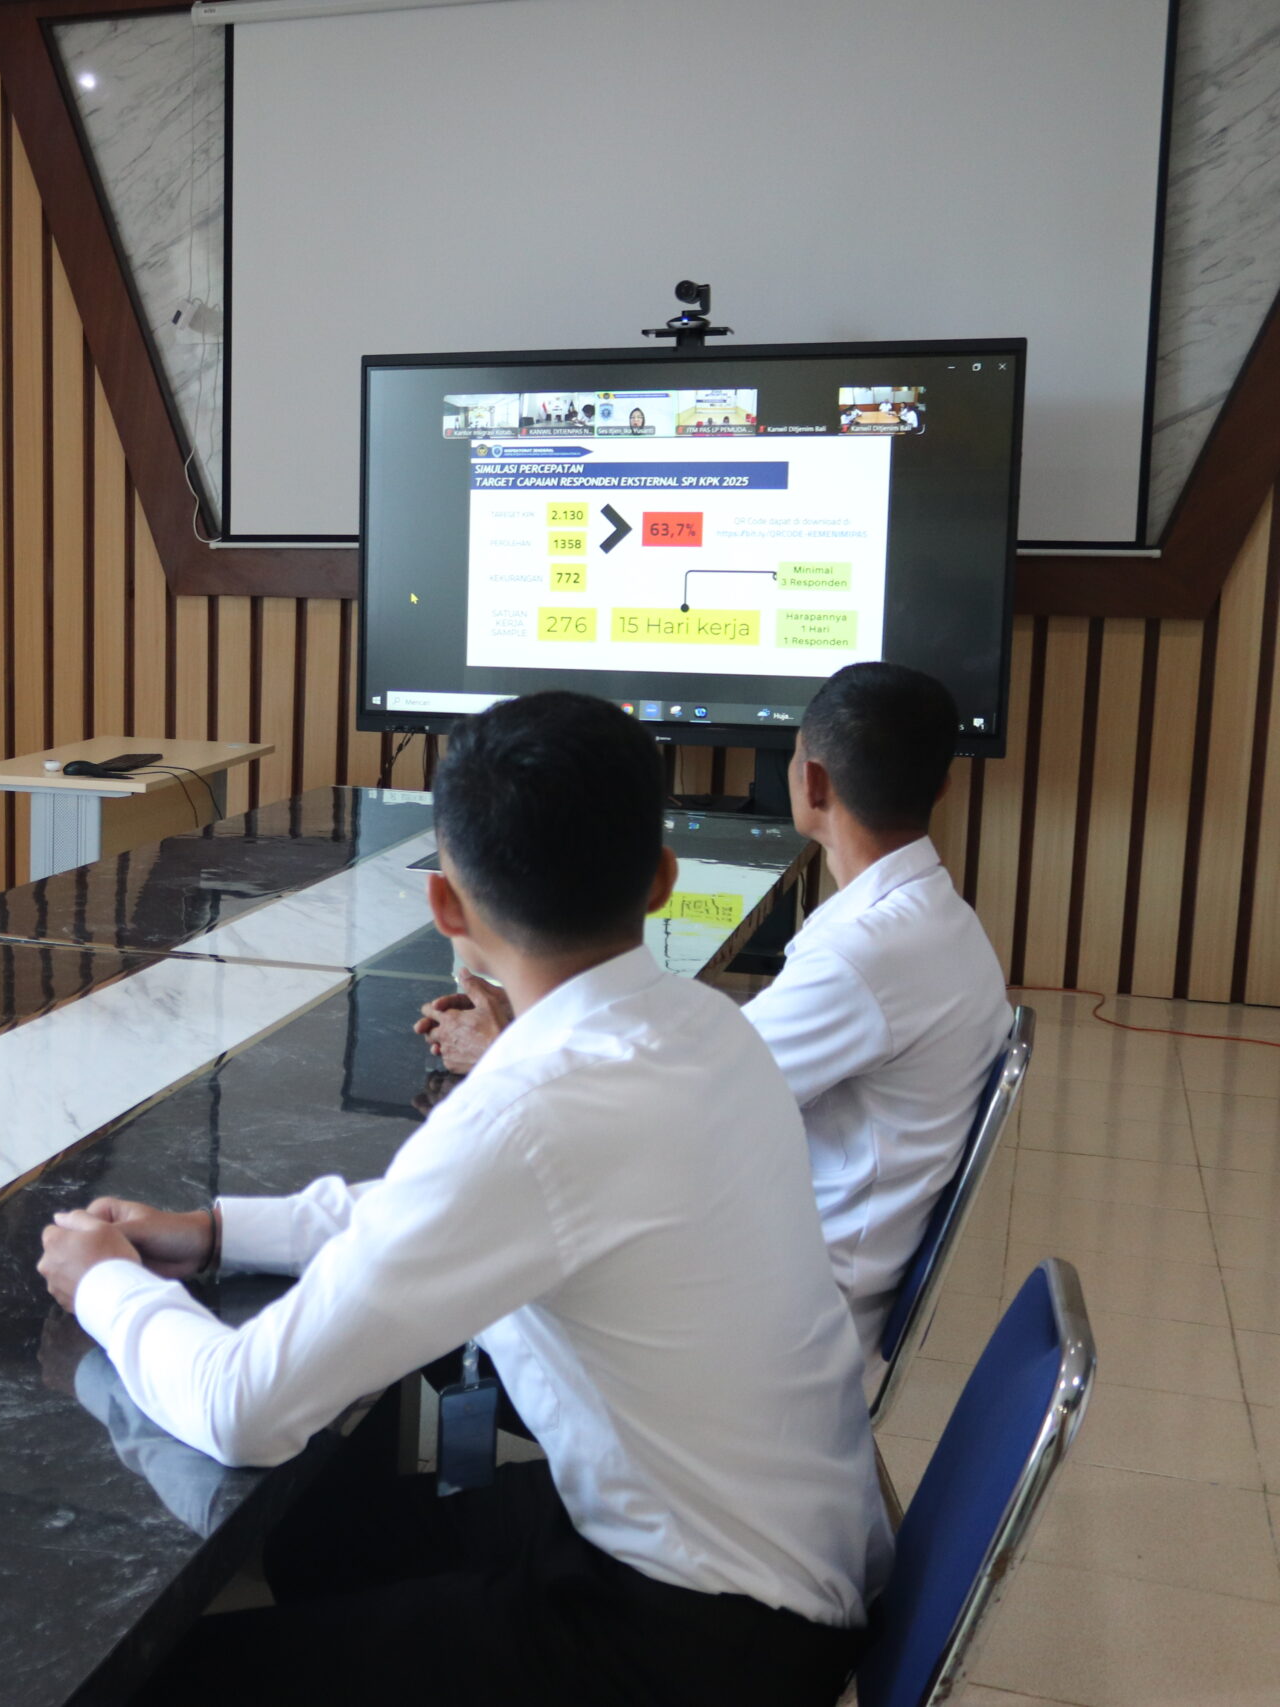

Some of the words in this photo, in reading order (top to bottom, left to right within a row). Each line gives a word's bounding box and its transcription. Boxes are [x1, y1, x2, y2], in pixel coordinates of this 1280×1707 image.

[815, 425, 827, 433] Bali
[474, 464, 518, 474] SIMULASI
[519, 463, 584, 473] PERCEPATAN
[475, 477, 514, 487] TARGET
[516, 477, 558, 487] CAPAIAN
[559, 477, 619, 486] RESPONDEN
[620, 477, 680, 486] EKSTERNAL
[681, 476, 697, 486] SPI
[699, 476, 720, 486] KPK
[722, 476, 749, 486] 2025
[551, 510, 584, 520] 2.130
[649, 522, 696, 538] 63,7%
[553, 539, 582, 549] 1358
[793, 565, 833, 575] Minimal
[556, 572, 580, 584] 772
[781, 578, 787, 587] 3
[790, 579, 848, 589] Responden
[491, 609, 528, 618] SATUAN
[785, 612, 848, 623] Harapannya
[495, 619, 524, 627] KERJA
[546, 615, 588, 633] 276
[619, 616, 639, 633] 15
[646, 616, 690, 635] Hari
[698, 618, 750, 640] kerja
[490, 628, 528, 637] SAMPLE
[801, 625, 806, 633] 1
[809, 624, 831, 634] Hari
[783, 637, 789, 645] 1
[792, 637, 849, 648] Responden
